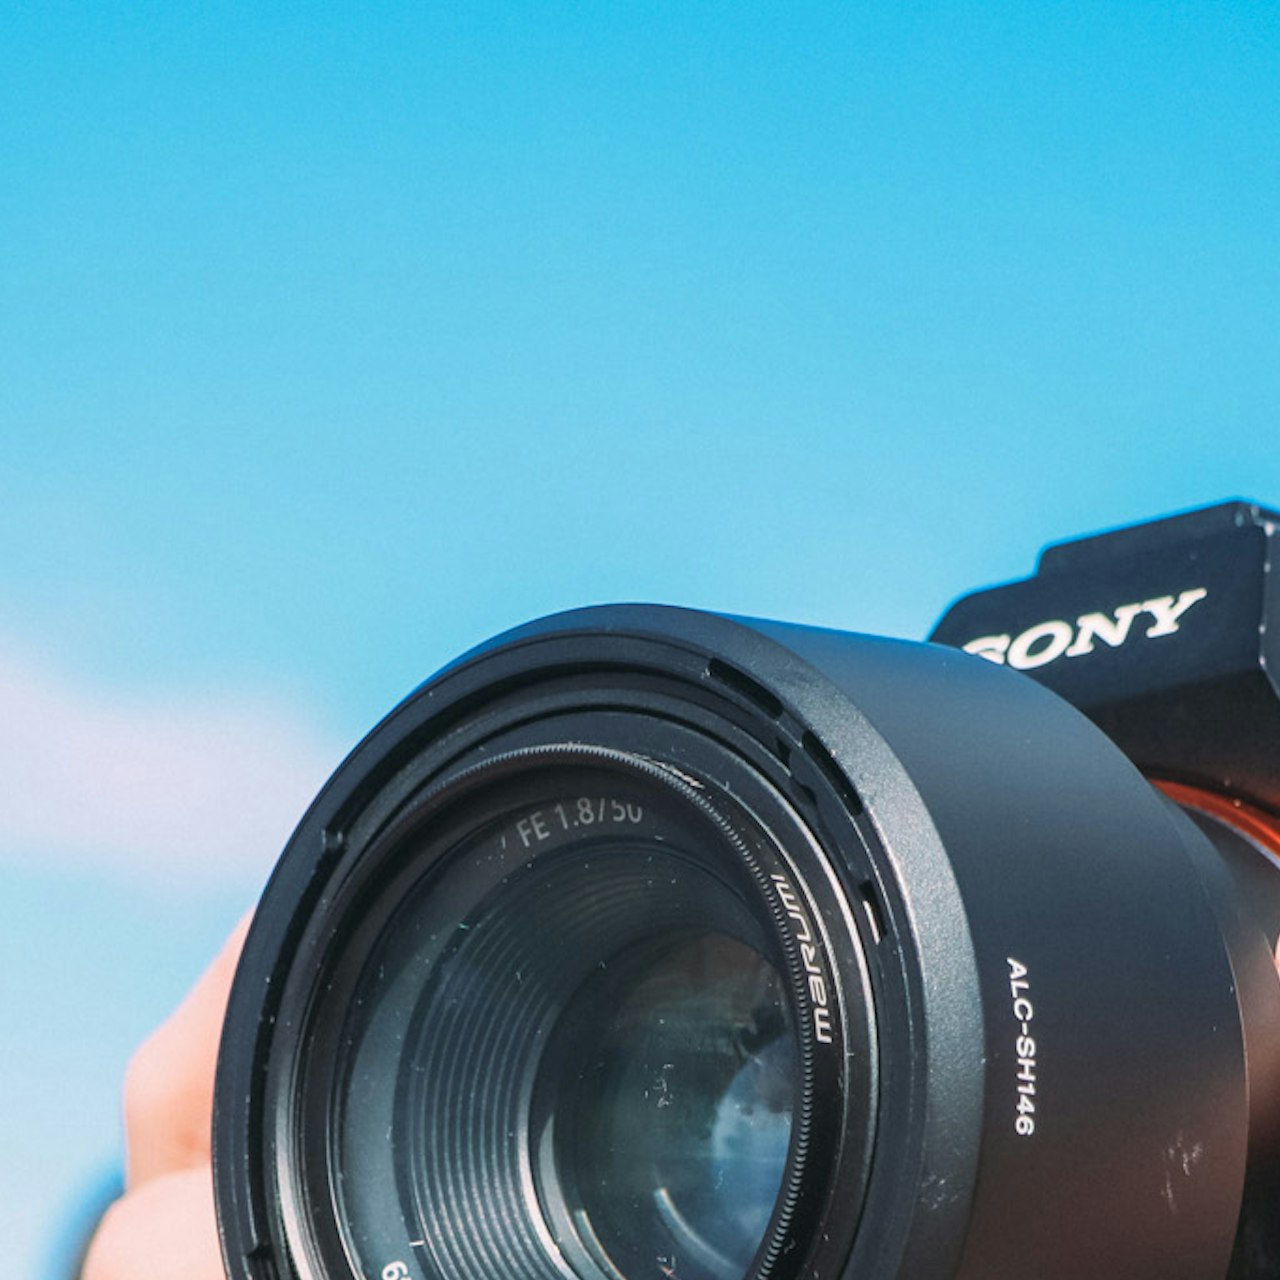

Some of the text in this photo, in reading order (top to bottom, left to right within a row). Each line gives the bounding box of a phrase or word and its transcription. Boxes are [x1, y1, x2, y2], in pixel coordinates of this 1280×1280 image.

[962, 587, 1208, 671] SONY
[516, 811, 551, 848] FE
[1006, 956, 1037, 1137] ALC-SH146
